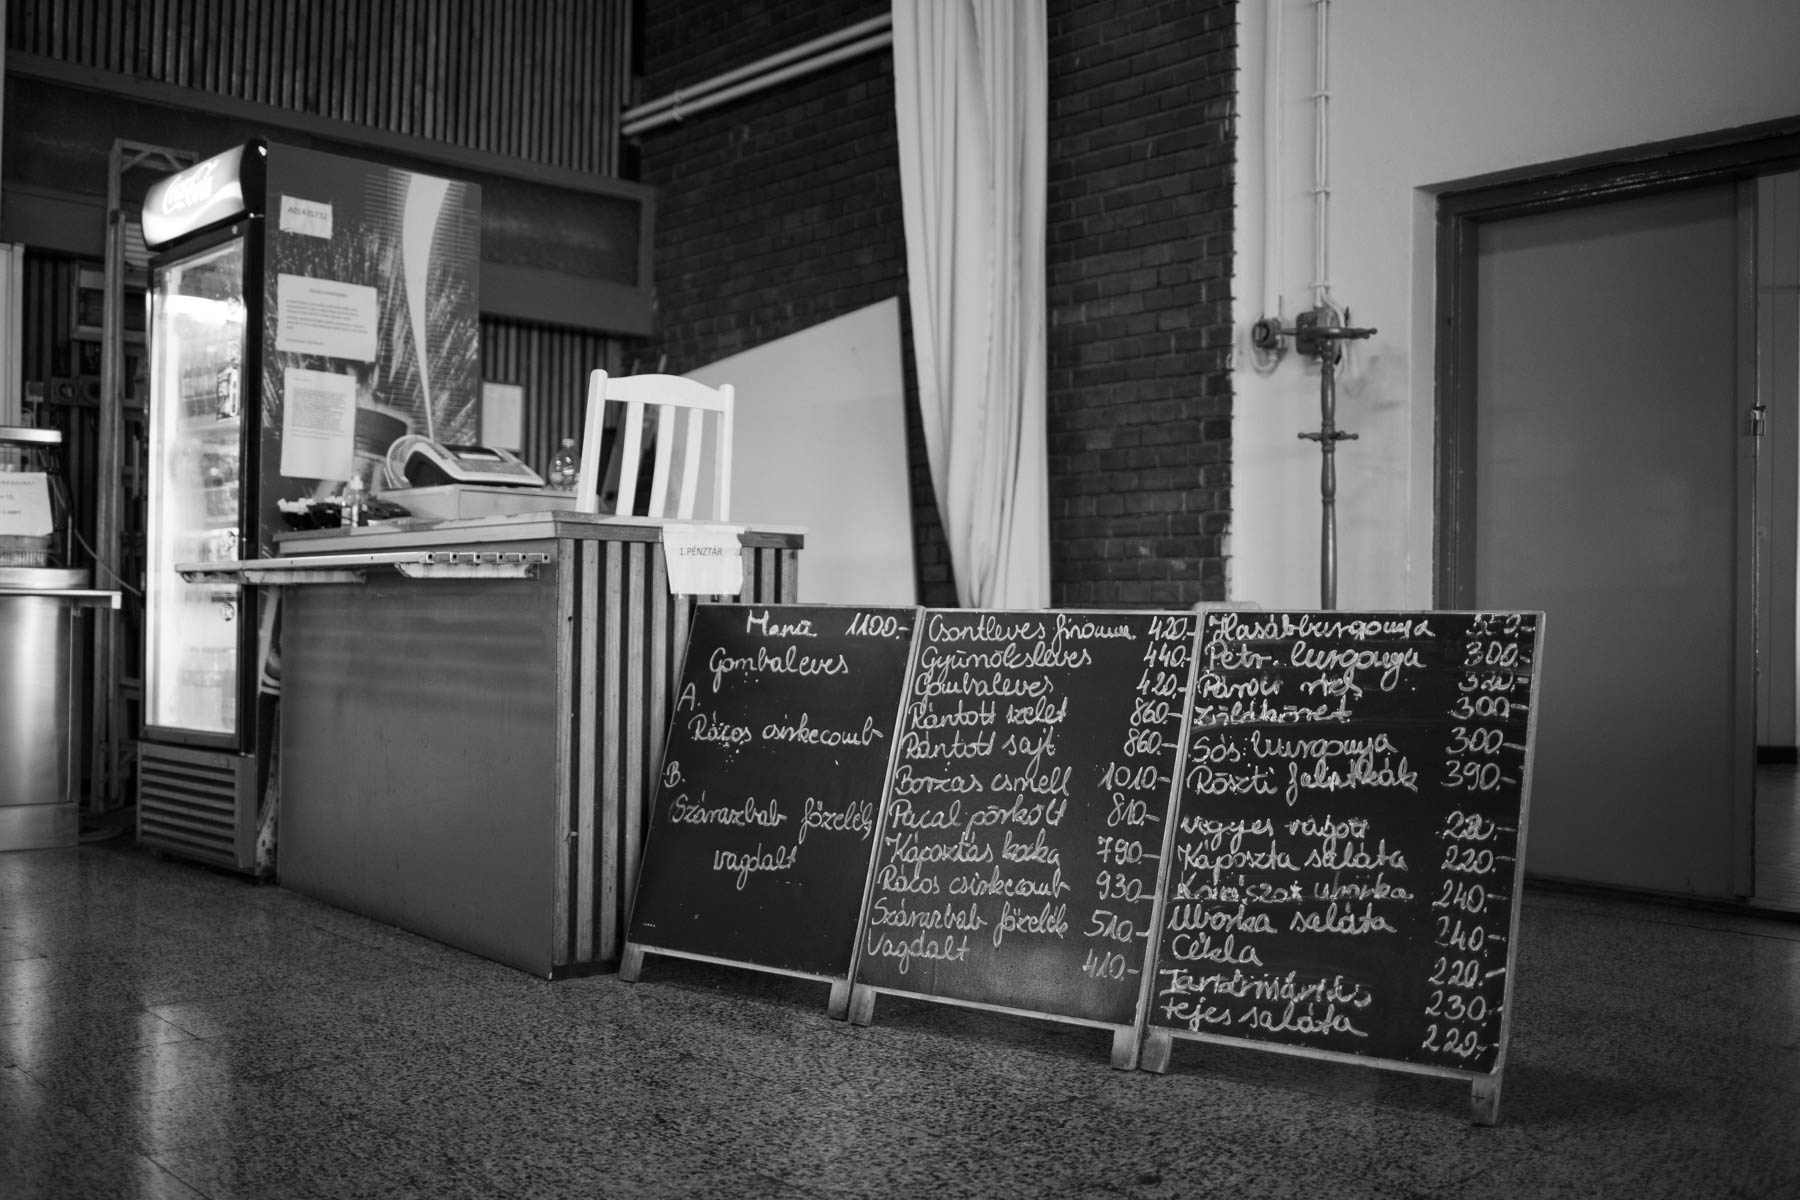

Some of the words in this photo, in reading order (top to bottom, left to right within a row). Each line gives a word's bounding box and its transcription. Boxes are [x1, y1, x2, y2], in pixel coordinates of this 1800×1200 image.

[928, 613, 1046, 642] Csontleves
[709, 645, 849, 693] Gombaleves
[914, 671, 1054, 713] Gombaleves
[889, 798, 962, 829] Pacal
